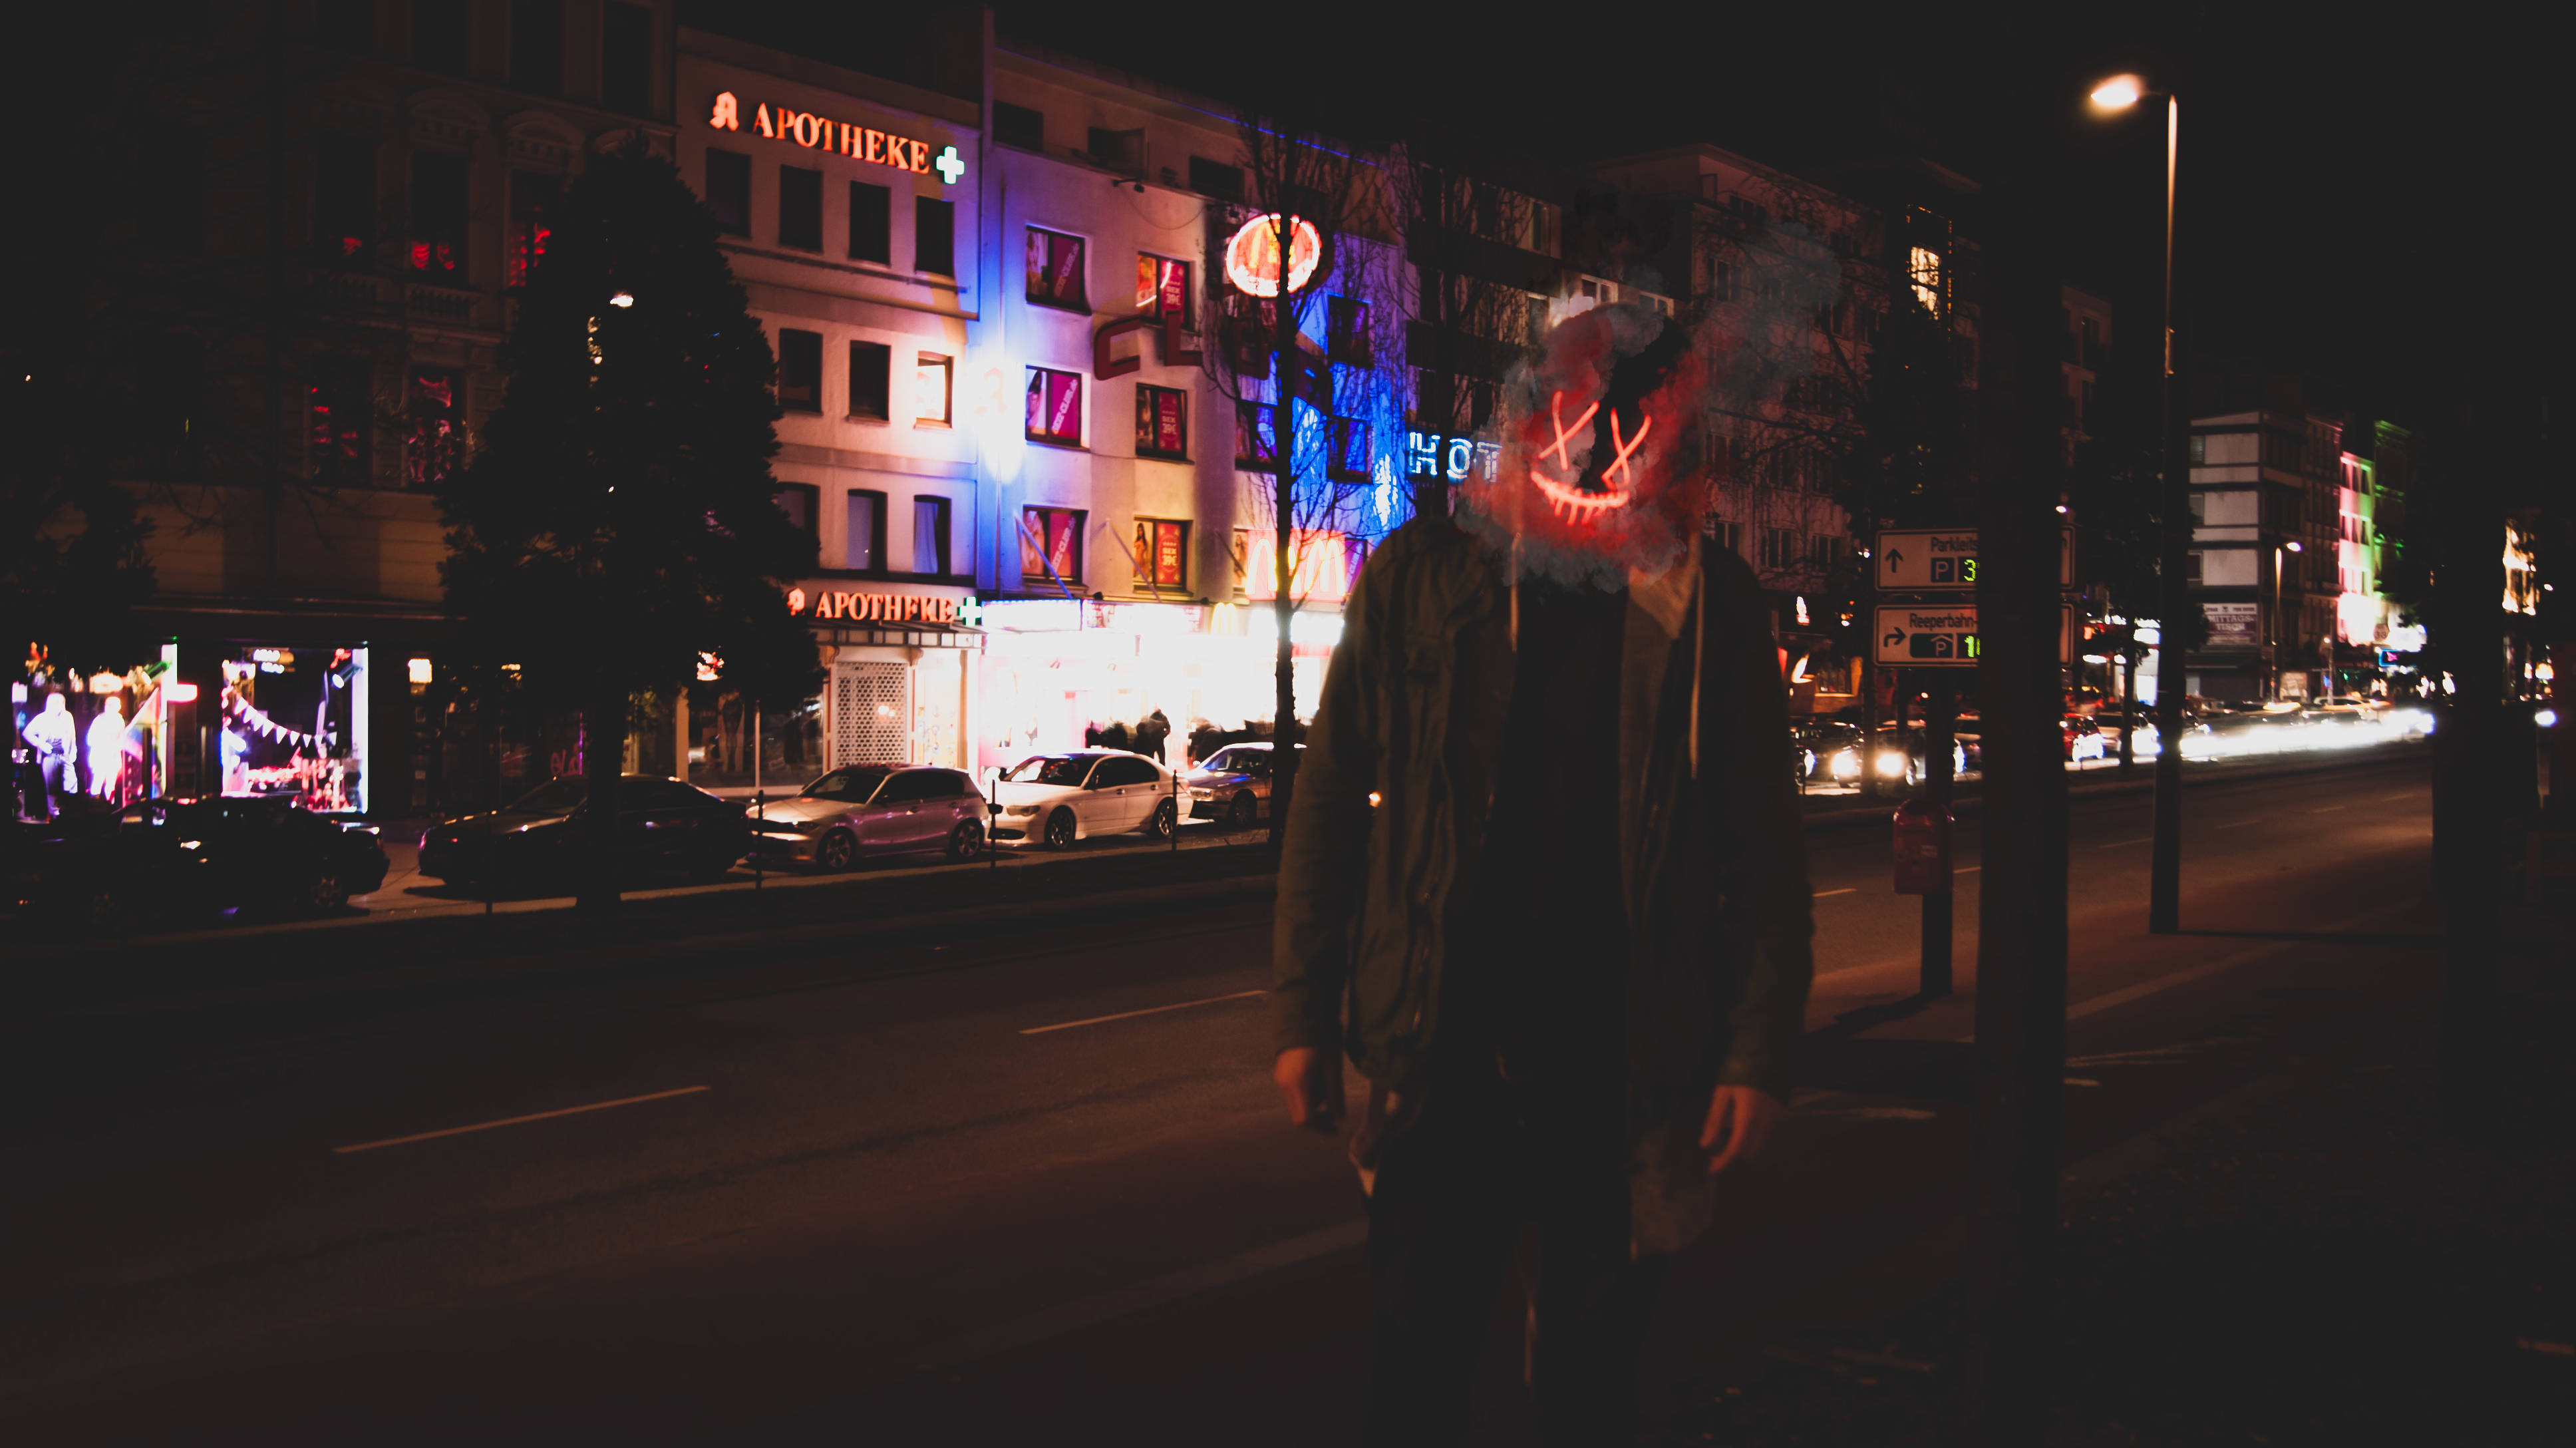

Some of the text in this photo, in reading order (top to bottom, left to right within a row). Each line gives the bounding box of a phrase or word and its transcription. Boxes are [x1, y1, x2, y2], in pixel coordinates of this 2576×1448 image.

[752, 102, 930, 174] APOTHEKE
[1408, 431, 1503, 483] HOT
[1931, 536, 1980, 552] Parkleits
[1963, 559, 1979, 582] 3
[815, 591, 955, 624] APOTHEKE
[1909, 613, 1979, 631] Reeperbahn-
[1964, 635, 1981, 658] 1
